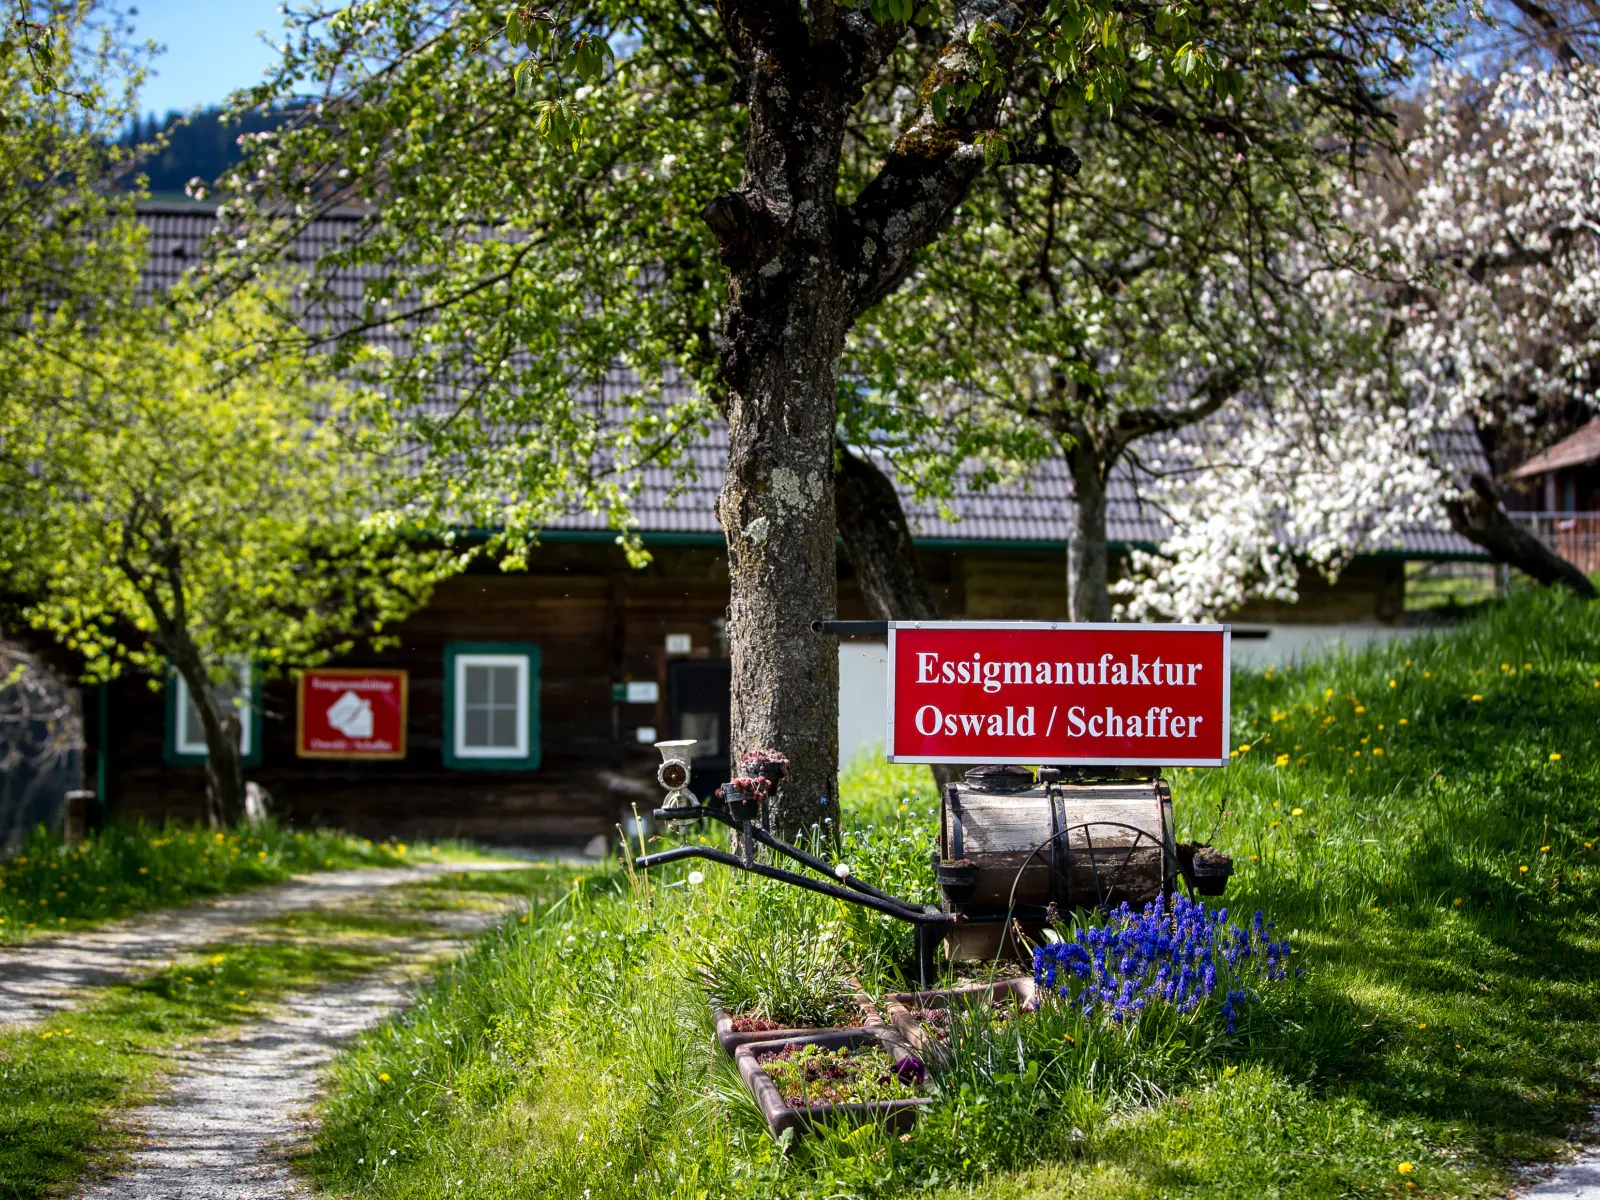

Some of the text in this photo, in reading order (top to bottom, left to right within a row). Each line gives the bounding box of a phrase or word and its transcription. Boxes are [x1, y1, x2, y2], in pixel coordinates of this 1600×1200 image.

[915, 652, 1203, 694] Essigmanufaktur
[914, 704, 1204, 739] Oswald / Schaffer
